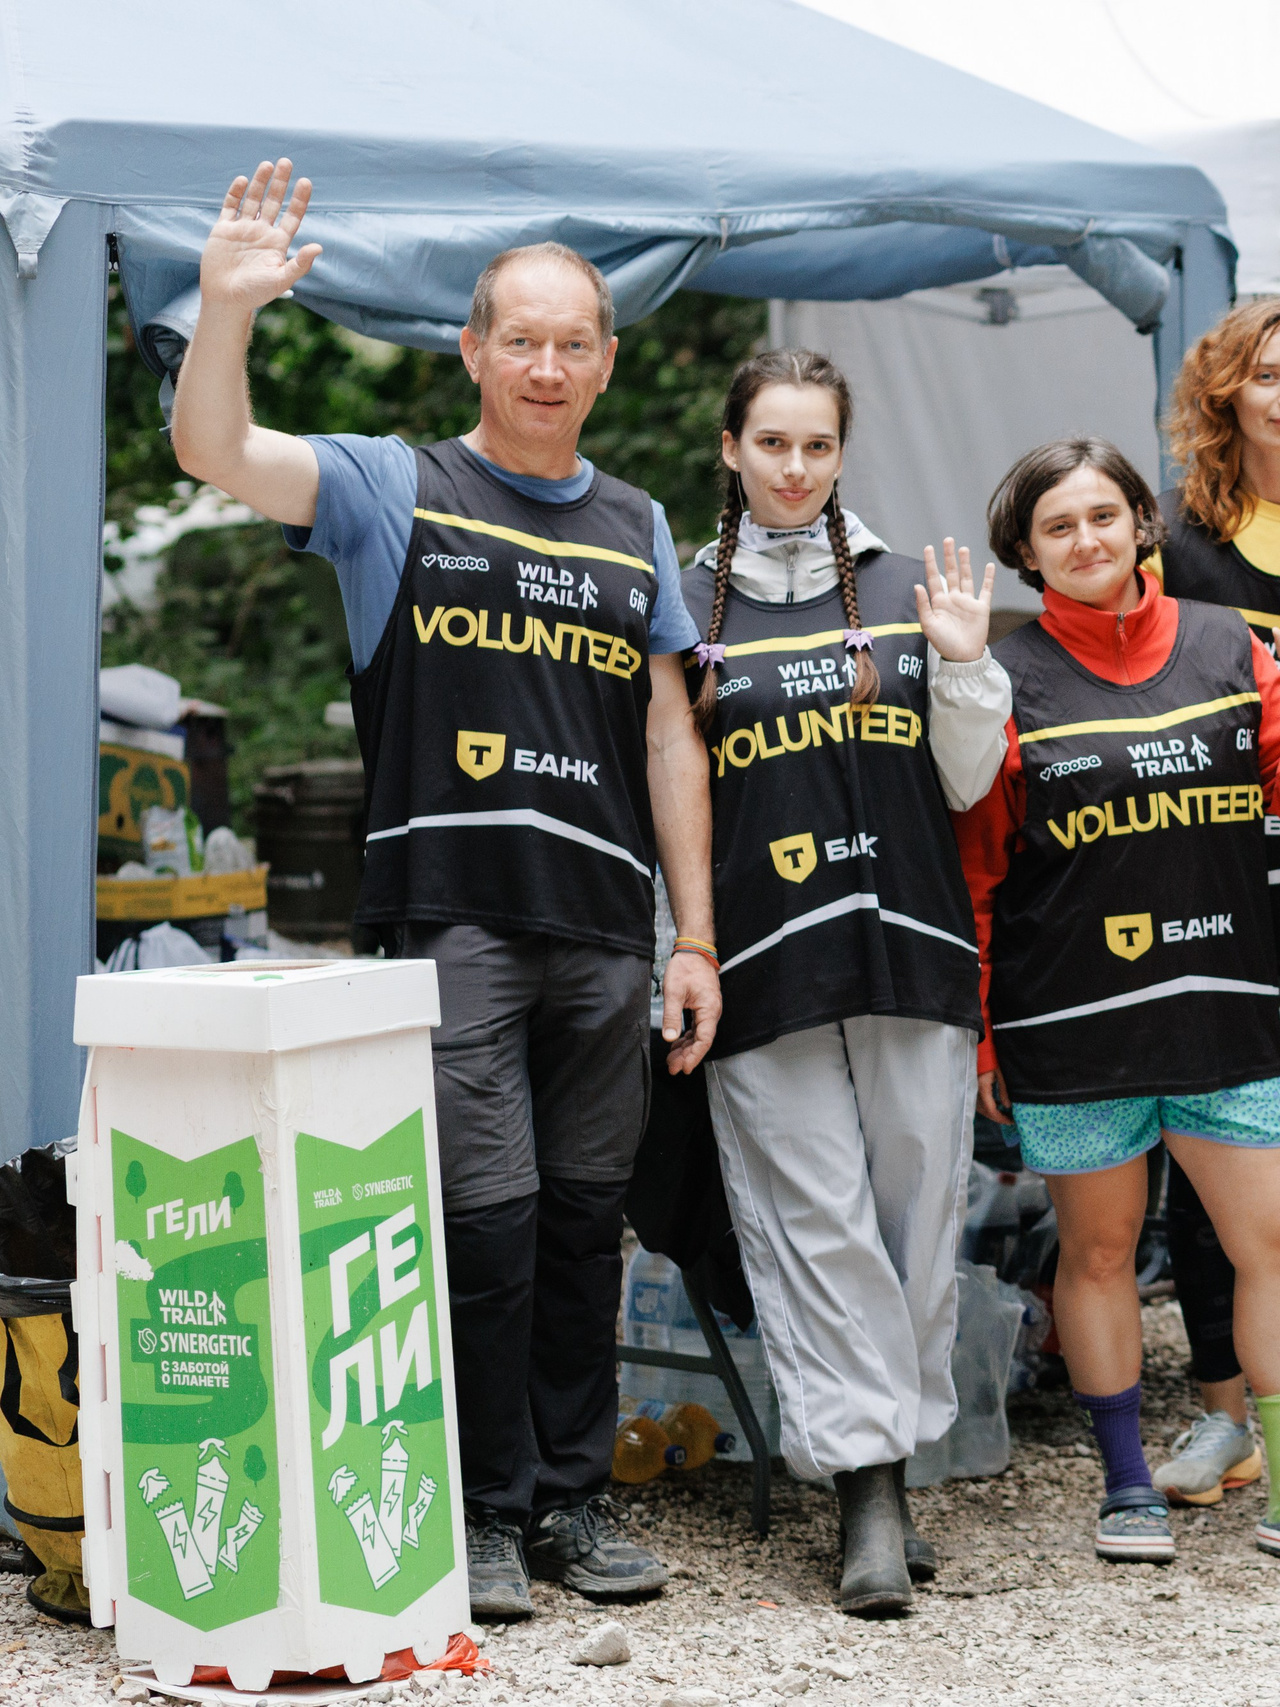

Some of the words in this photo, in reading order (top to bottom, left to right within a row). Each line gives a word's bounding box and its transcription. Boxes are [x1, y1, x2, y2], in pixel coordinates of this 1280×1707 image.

[438, 554, 490, 572] Tooba
[516, 561, 574, 588] WILD
[516, 581, 579, 609] TRAIL
[778, 658, 836, 680] WILD
[781, 674, 845, 697] TRAIL
[1127, 739, 1185, 761] WILD
[513, 748, 599, 785] БАНК
[1051, 755, 1102, 777] Tooba
[1131, 757, 1195, 778] TRAIL
[1046, 784, 1263, 850] VOLUNTEER
[1162, 913, 1234, 943] БАНК
[313, 1188, 335, 1200] WILD
[364, 1175, 414, 1198] SYNERGETIC
[314, 1198, 338, 1209] TRAIL
[146, 1196, 231, 1240] ГЕЛИ
[328, 1204, 421, 1338] ГЕ
[158, 1288, 208, 1307] WILD
[159, 1306, 213, 1326] TRAIL
[160, 1331, 252, 1356] SYNERGETIC
[161, 1360, 170, 1372] С
[172, 1361, 229, 1375] ЗАБОТОЙ
[322, 1300, 433, 1450] ЛИ
[161, 1373, 171, 1385] О
[172, 1374, 230, 1388] ПЛАНЕТЕ
